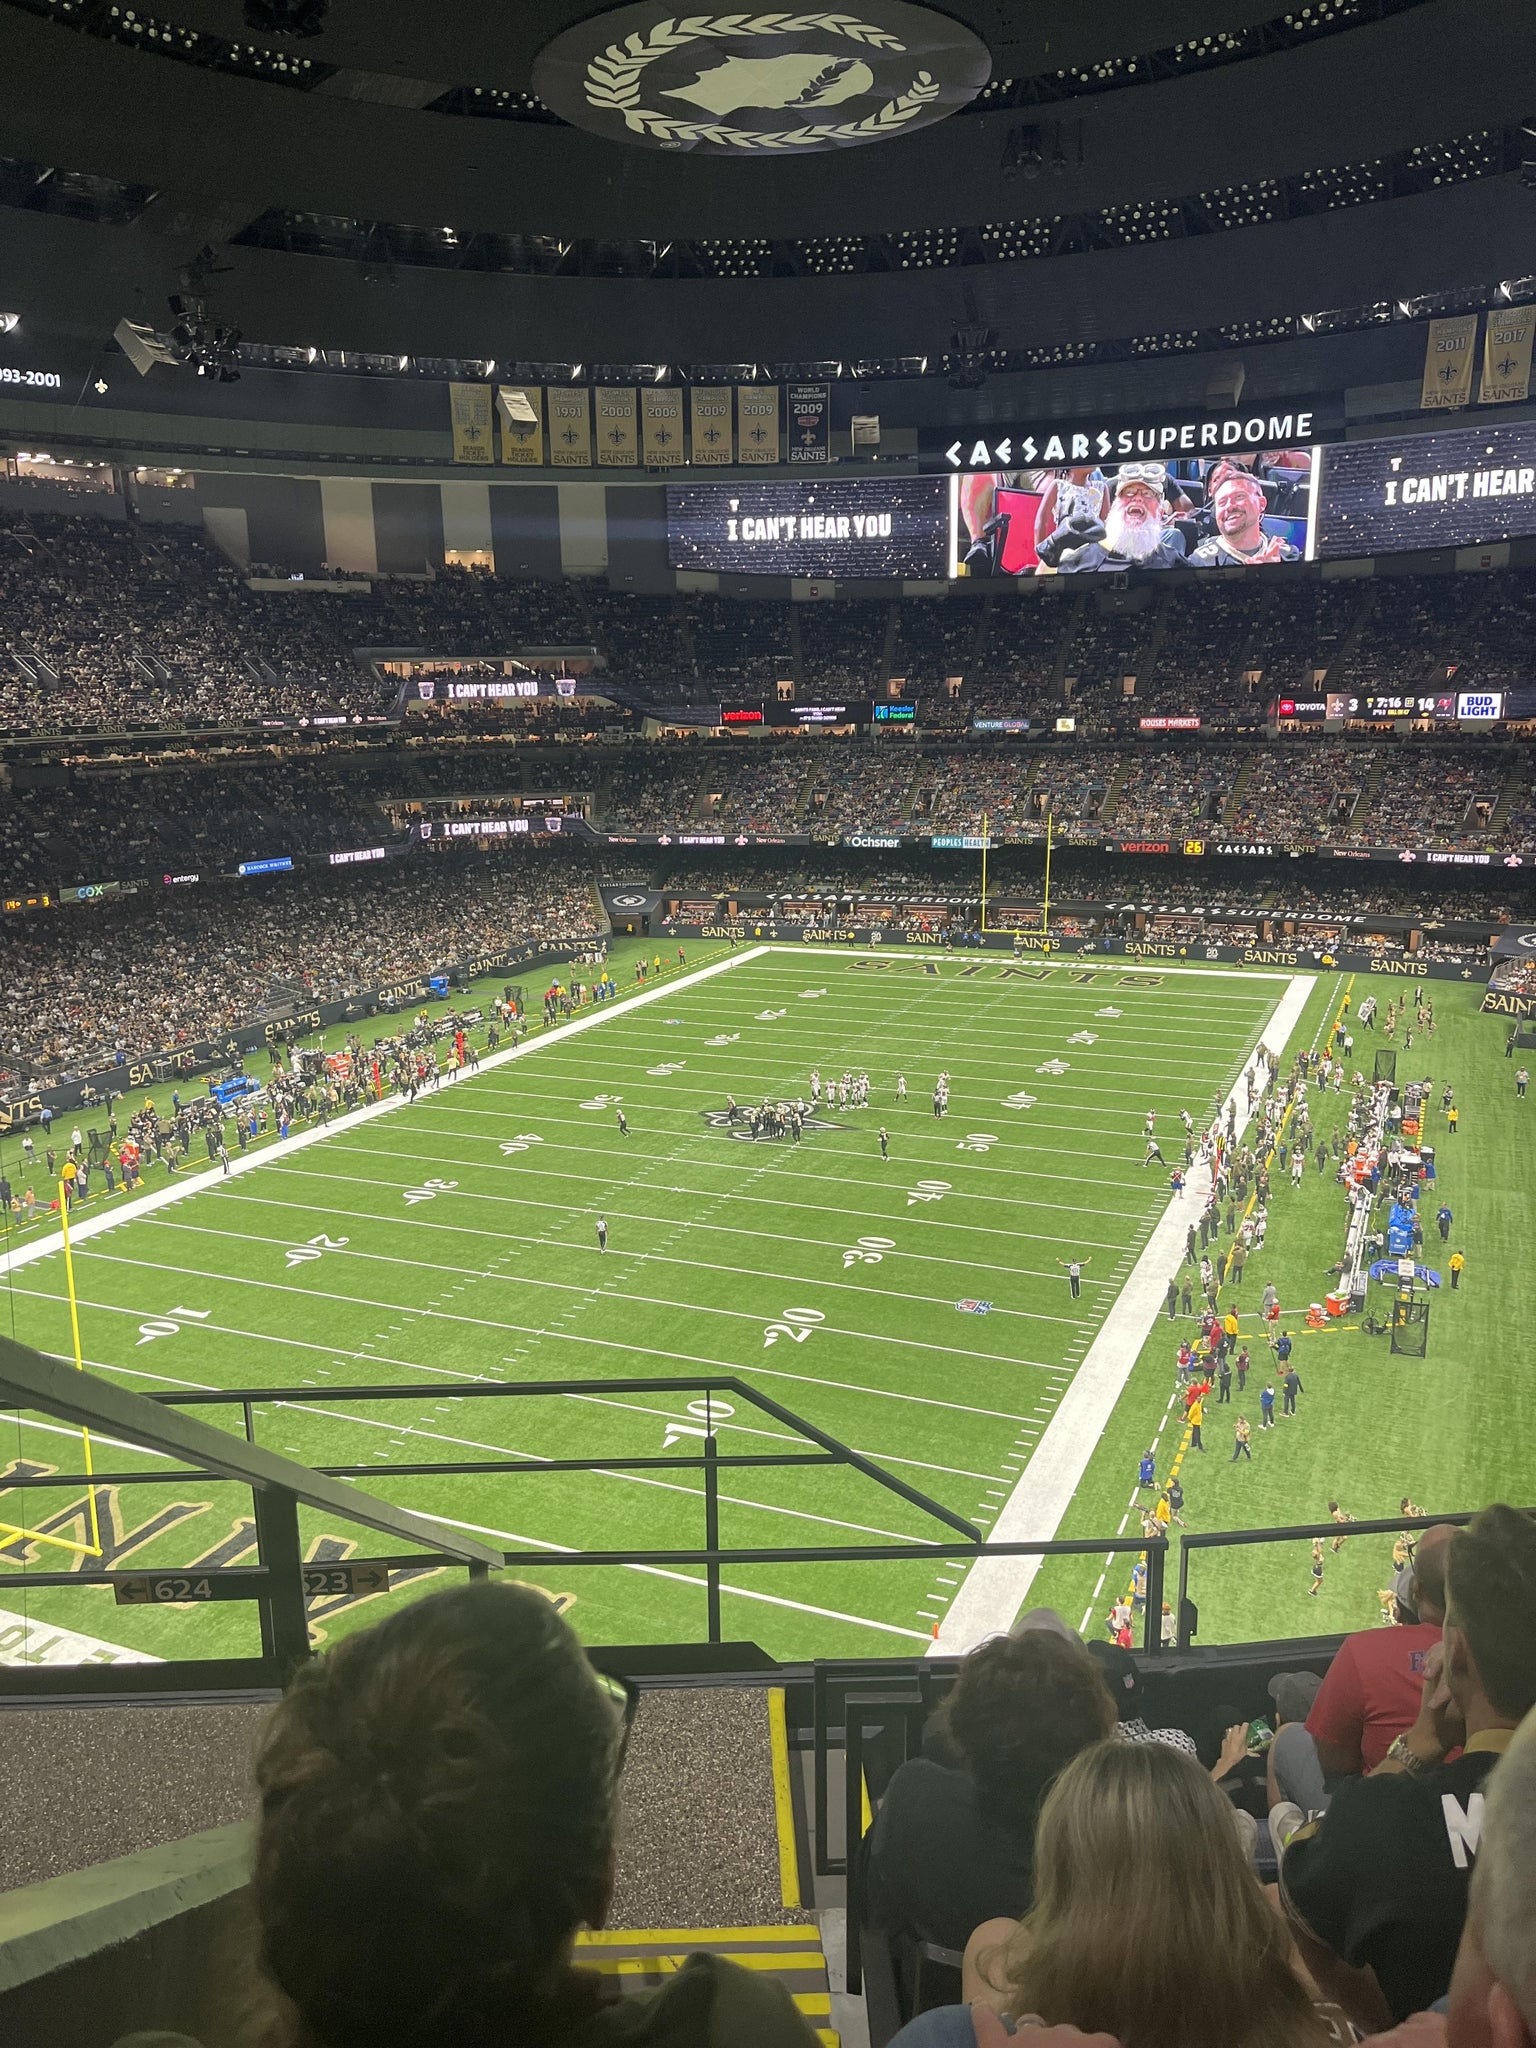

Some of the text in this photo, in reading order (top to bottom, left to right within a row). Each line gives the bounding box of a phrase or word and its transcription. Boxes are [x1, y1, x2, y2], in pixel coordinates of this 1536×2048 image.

[1494, 328, 1526, 345] 2017
[1436, 337, 1466, 352] 2011
[1424, 393, 1466, 407] SAINTS
[1483, 388, 1524, 401] SAINTS
[555, 407, 581, 417] 1991
[601, 406, 631, 417] 2000
[648, 407, 677, 418] 2006
[697, 405, 727, 416] 2009
[744, 405, 773, 416] 2009
[794, 403, 823, 414] 2009
[945, 413, 1313, 467] CAESARS SUPERDOME
[554, 455, 588, 464] SAINTS
[600, 454, 635, 464] SAINTS
[646, 455, 681, 464] SAINTS
[695, 453, 730, 462] SAINTS
[741, 452, 776, 462] SAINTS
[791, 451, 826, 461] SAINTS
[1385, 468, 1536, 505] I CAN'T HEAR
[727, 514, 892, 541] I CAN'T HEAR YOU
[456, 683, 487, 698] CAN'T
[488, 683, 515, 698] HEAR
[516, 682, 538, 697] YOU
[1348, 699, 1358, 711] 3
[1377, 697, 1402, 708] 7:16
[1418, 698, 1435, 711] 14
[1466, 697, 1493, 706] BUD
[723, 710, 762, 721] verizon
[1460, 706, 1497, 716] LIGHT
[159, 723, 186, 731] SAINTS
[218, 720, 244, 728] SAINTS
[1141, 718, 1199, 727] ROUSES MARKETS
[1210, 717, 1239, 725] SAINTS
[30, 728, 61, 737] SAINTS
[97, 725, 127, 734] SAINTS
[451, 822, 481, 836] CAN'T
[481, 821, 507, 833] HEAR
[509, 819, 529, 832] YOU
[813, 834, 840, 842] SAINTS
[851, 837, 900, 848] Ochsner
[933, 837, 990, 847] PEOPLES HEALTH
[1004, 837, 1033, 845] SAINTS
[1068, 838, 1098, 846] SAINTS
[1121, 841, 1169, 852] verizon
[1186, 842, 1201, 853] 26
[1216, 844, 1273, 855] CAESARS
[1284, 845, 1316, 853] SAINTS
[1333, 849, 1371, 858] New Orleans
[1433, 853, 1454, 862] CAN'T
[1454, 854, 1473, 863] HEAR
[1474, 855, 1490, 864] YOU
[121, 879, 149, 889] SAINTS
[173, 874, 199, 883] entergy
[77, 885, 104, 898] COX
[766, 892, 991, 905] CAESARS SUPERDOME
[1105, 903, 1367, 923] CAESARS SUPERDOME
[702, 926, 745, 938] SAINTS
[906, 932, 944, 944] SAINT
[1125, 942, 1175, 956] SAINTS
[1244, 950, 1297, 965] SAINTS
[1370, 959, 1428, 975] SAINTS
[845, 960, 1166, 987] SAINTS
[703, 1032, 741, 1046] 30
[1066, 1031, 1099, 1045] 20
[646, 1060, 688, 1076] 40
[1035, 1060, 1071, 1075] 30
[578, 1094, 624, 1110] 50
[1001, 1095, 1038, 1109] 40
[498, 1132, 545, 1152] 40
[956, 1133, 999, 1152] 50
[402, 1178, 459, 1201] 30
[912, 1180, 953, 1202] 40
[285, 1233, 350, 1262] 20
[842, 1236, 896, 1264] 30
[138, 1305, 212, 1338] 10
[763, 1307, 826, 1343] 20
[664, 1399, 736, 1437] 10
[154, 1579, 212, 1600] 624
